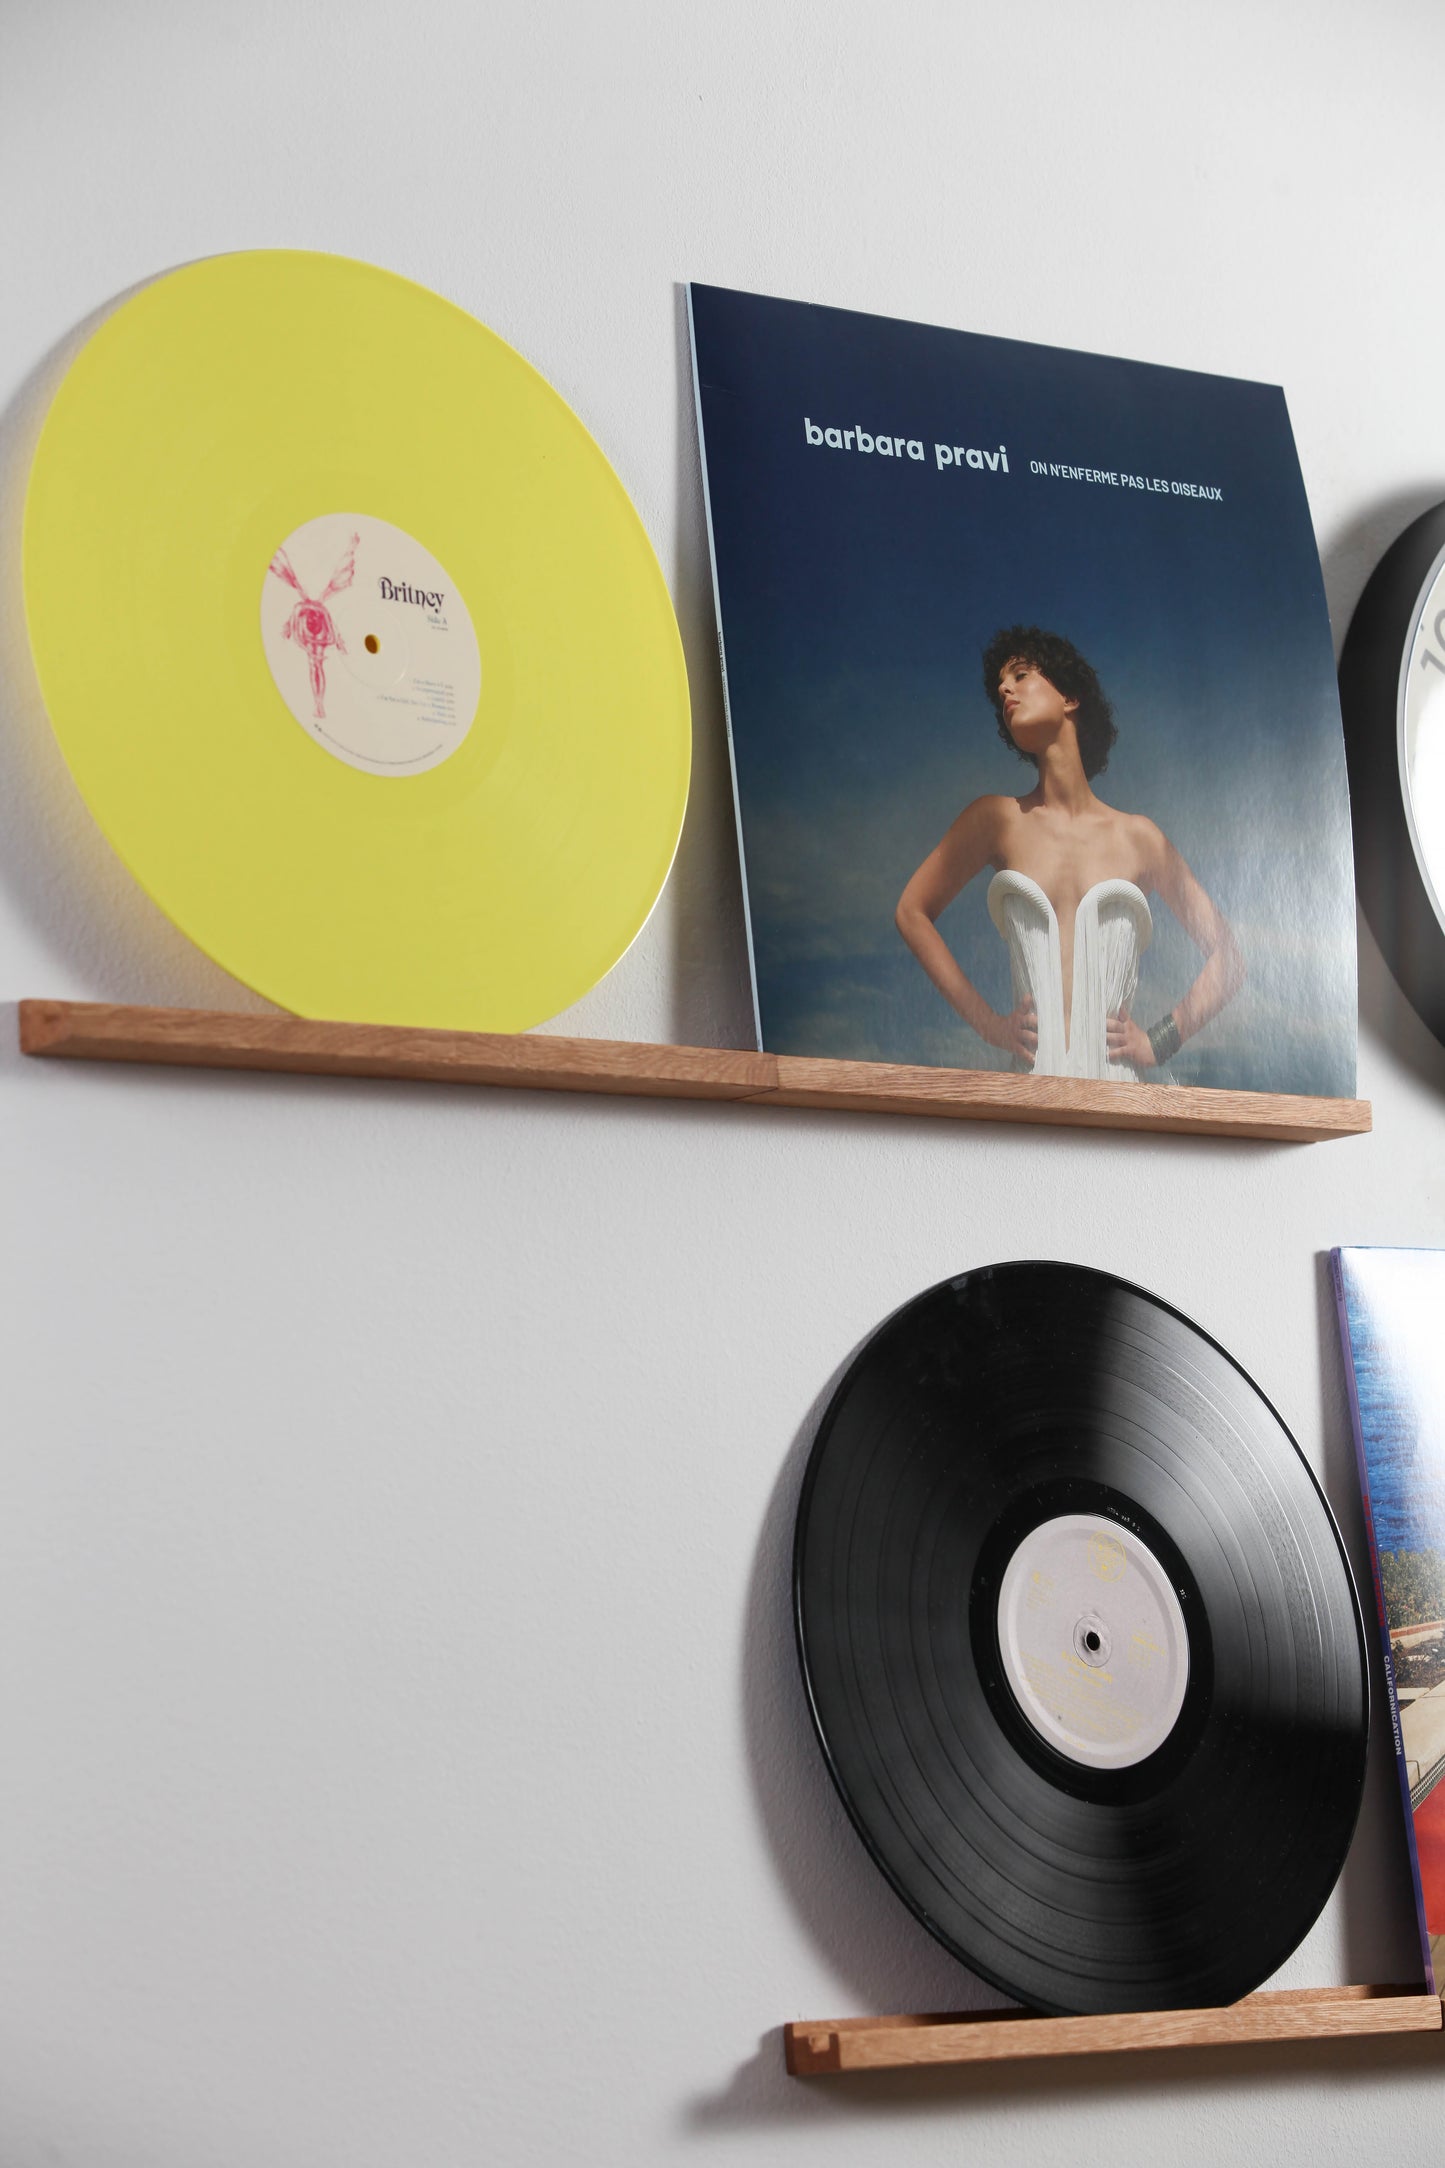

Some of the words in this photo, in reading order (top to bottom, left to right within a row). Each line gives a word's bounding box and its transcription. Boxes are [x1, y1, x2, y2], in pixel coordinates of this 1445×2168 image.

[803, 417, 926, 461] barbara
[934, 443, 1010, 474] pravi
[1030, 460, 1048, 476] ON
[1049, 463, 1120, 487] N'ENFERME
[1120, 473, 1145, 490] PAS
[1146, 477, 1169, 494] LES
[1171, 481, 1224, 502] OISEAUX
[378, 576, 445, 615] Britney
[1383, 1655, 1402, 1756] CALIFORNICATION
